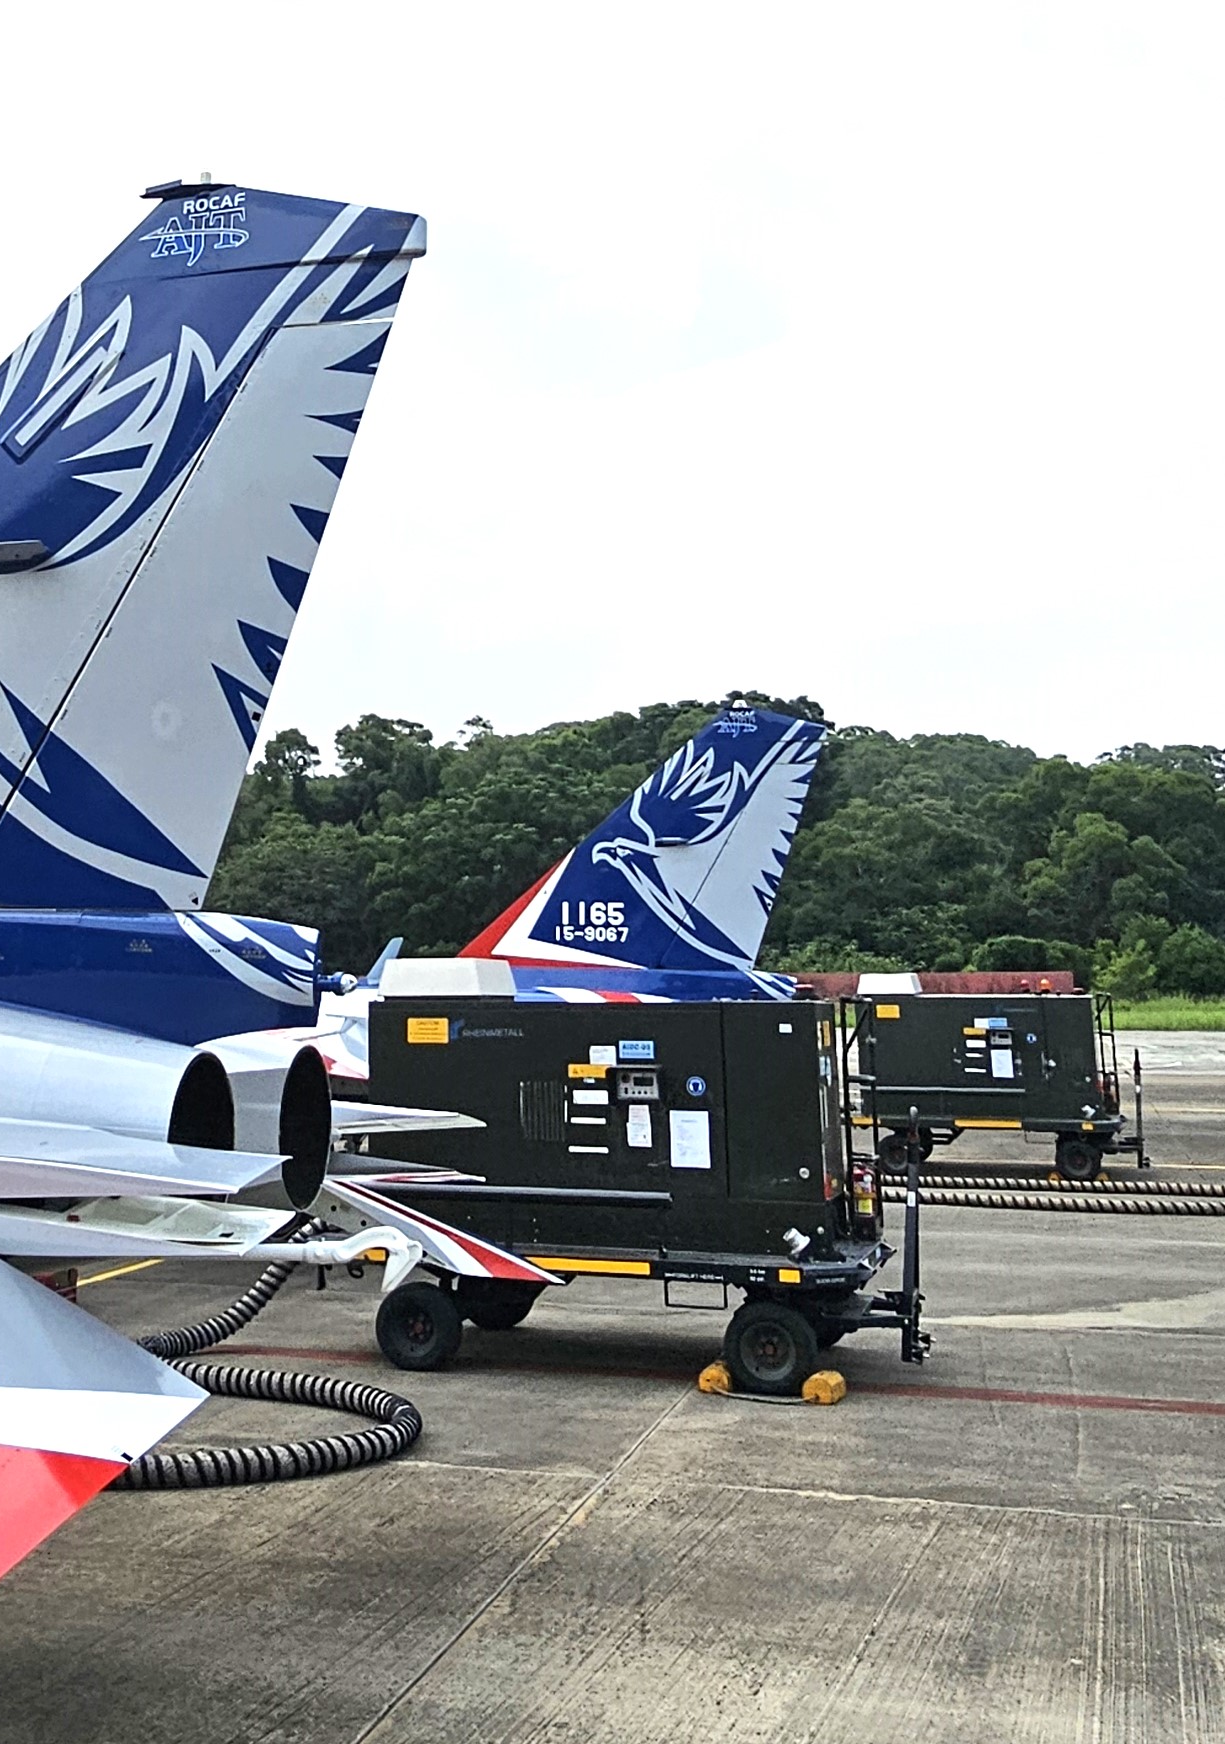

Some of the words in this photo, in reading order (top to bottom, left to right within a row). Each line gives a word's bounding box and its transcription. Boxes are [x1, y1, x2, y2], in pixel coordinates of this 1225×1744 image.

[182, 192, 246, 215] ROCAF
[146, 207, 248, 267] AJT
[561, 901, 625, 926] 1165
[555, 925, 629, 942] 15-9067
